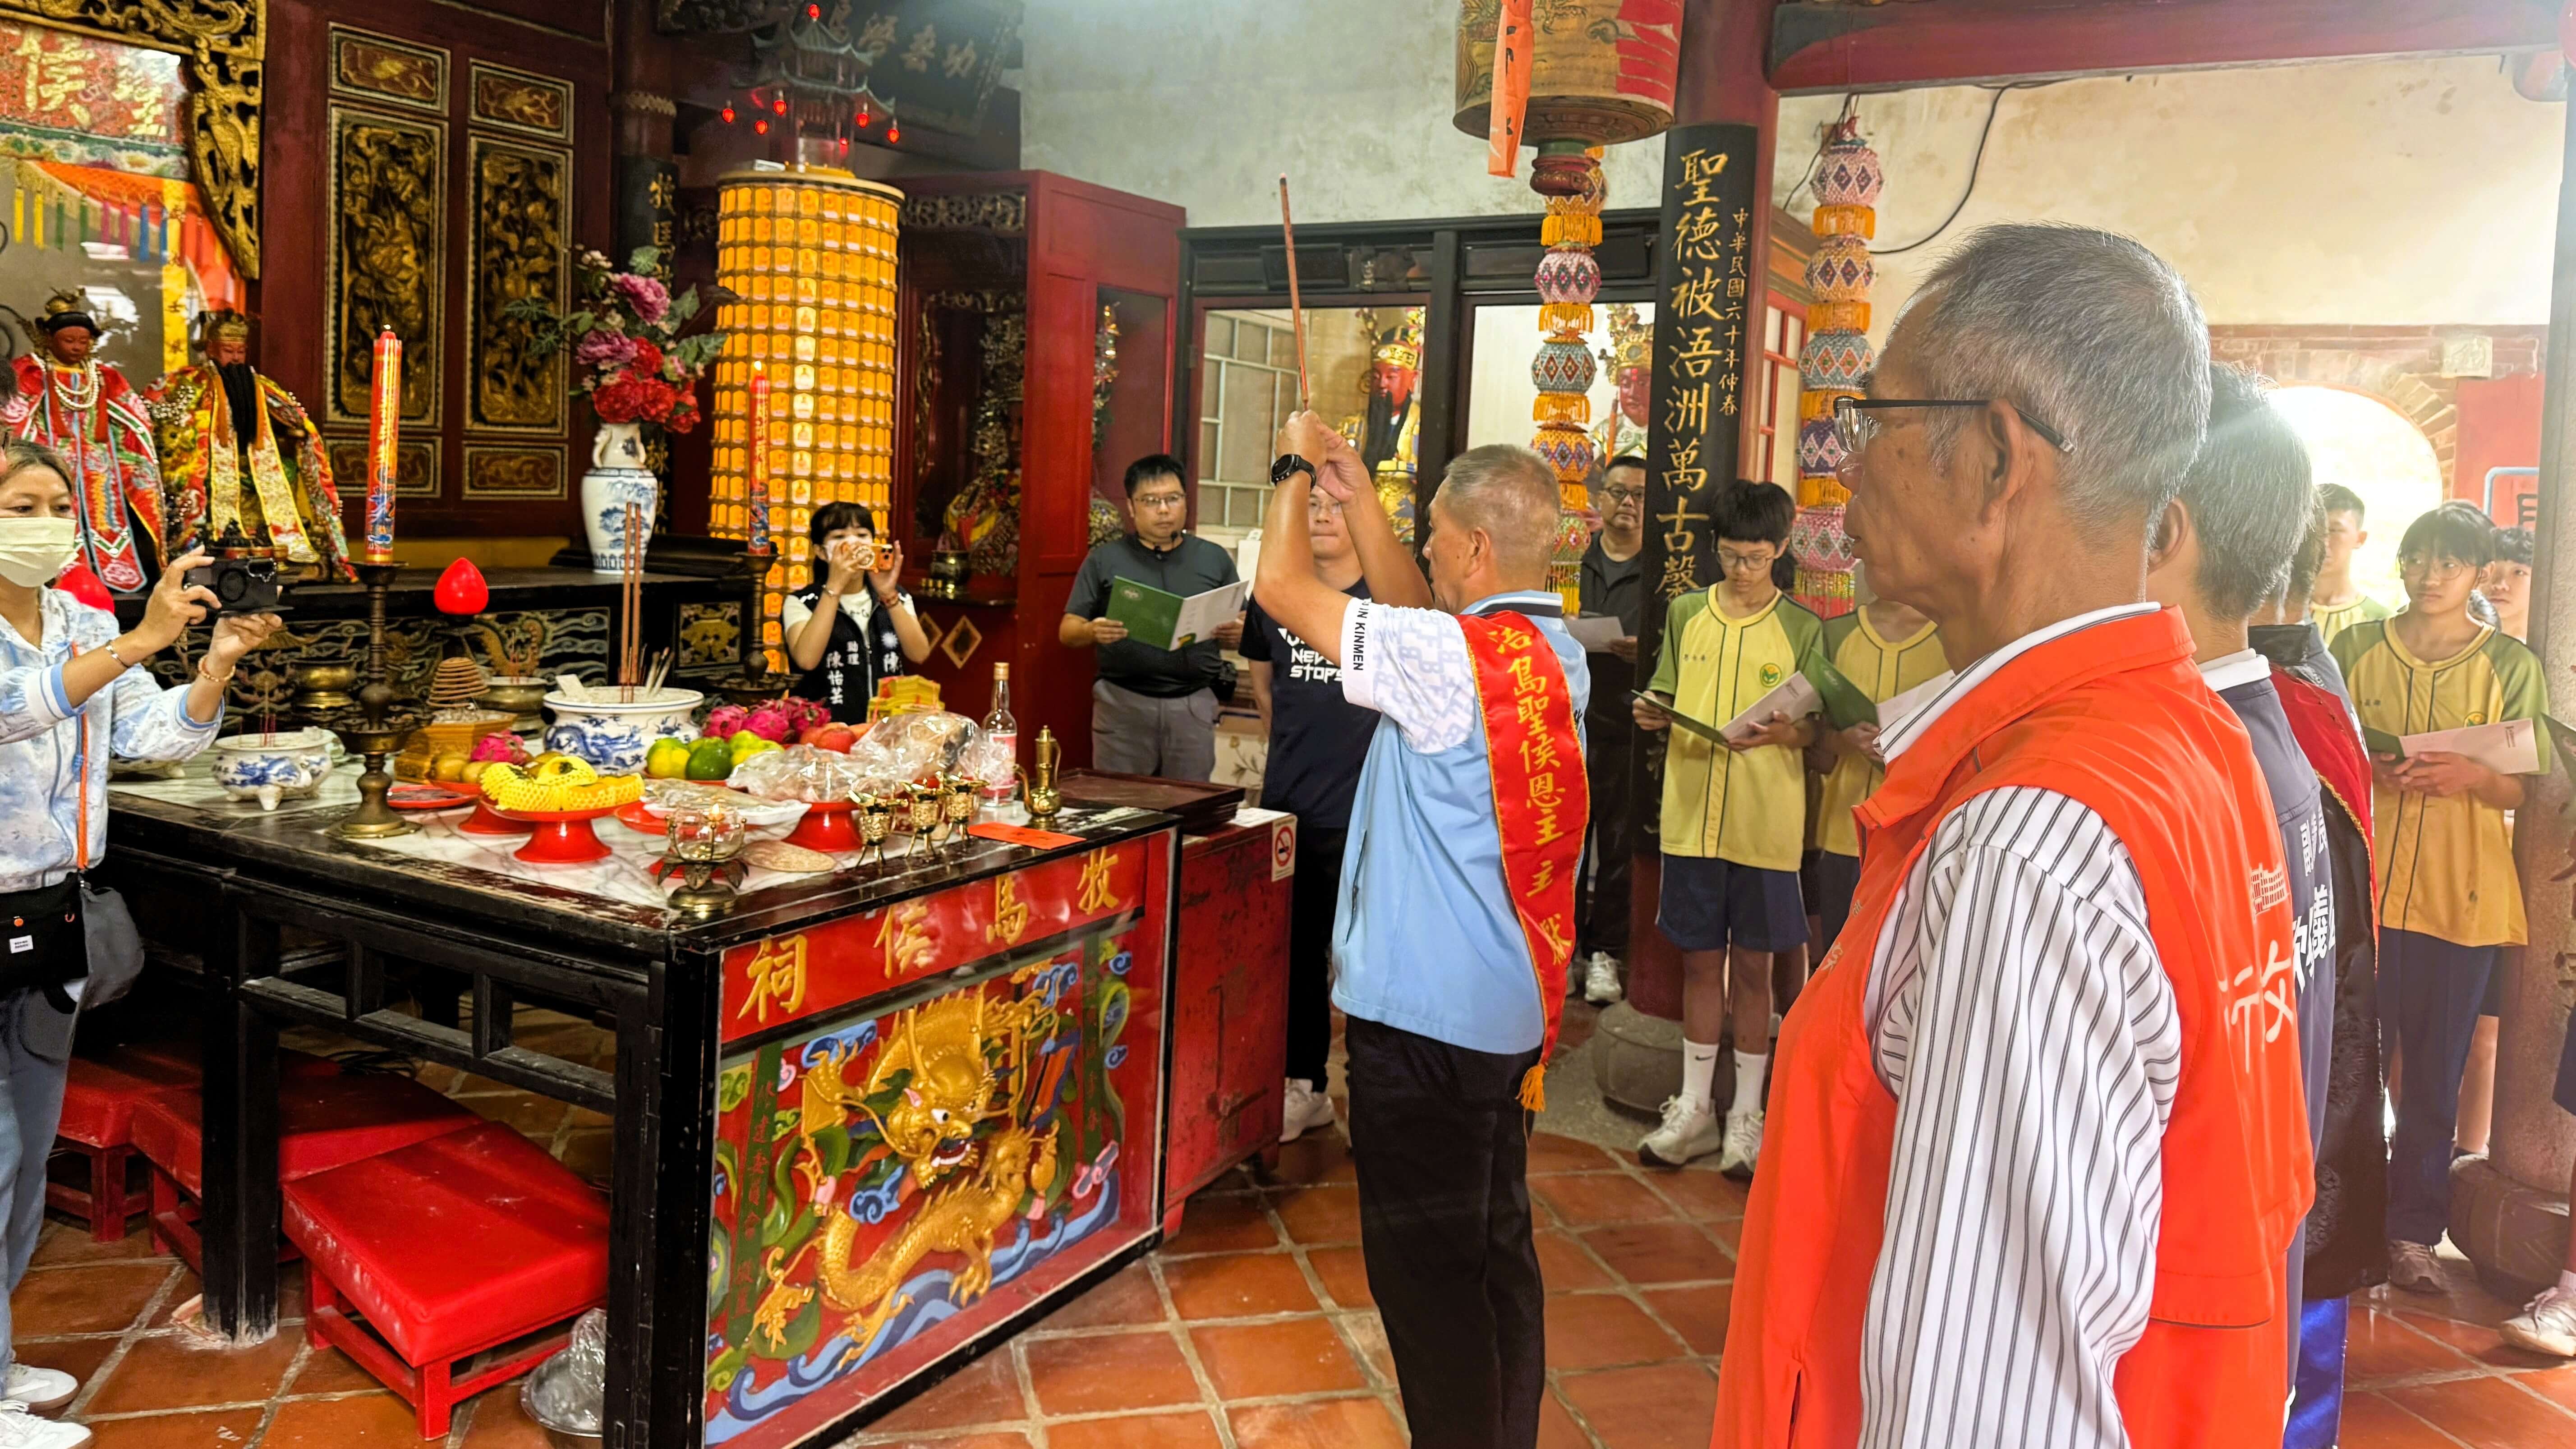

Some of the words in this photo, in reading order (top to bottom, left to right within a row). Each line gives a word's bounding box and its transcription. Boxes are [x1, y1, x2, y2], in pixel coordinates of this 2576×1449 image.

[1717, 207, 1749, 416] 中華民國六十年仲春
[1291, 647, 1336, 666] NEV
[1353, 622, 1366, 671] KINMEN
